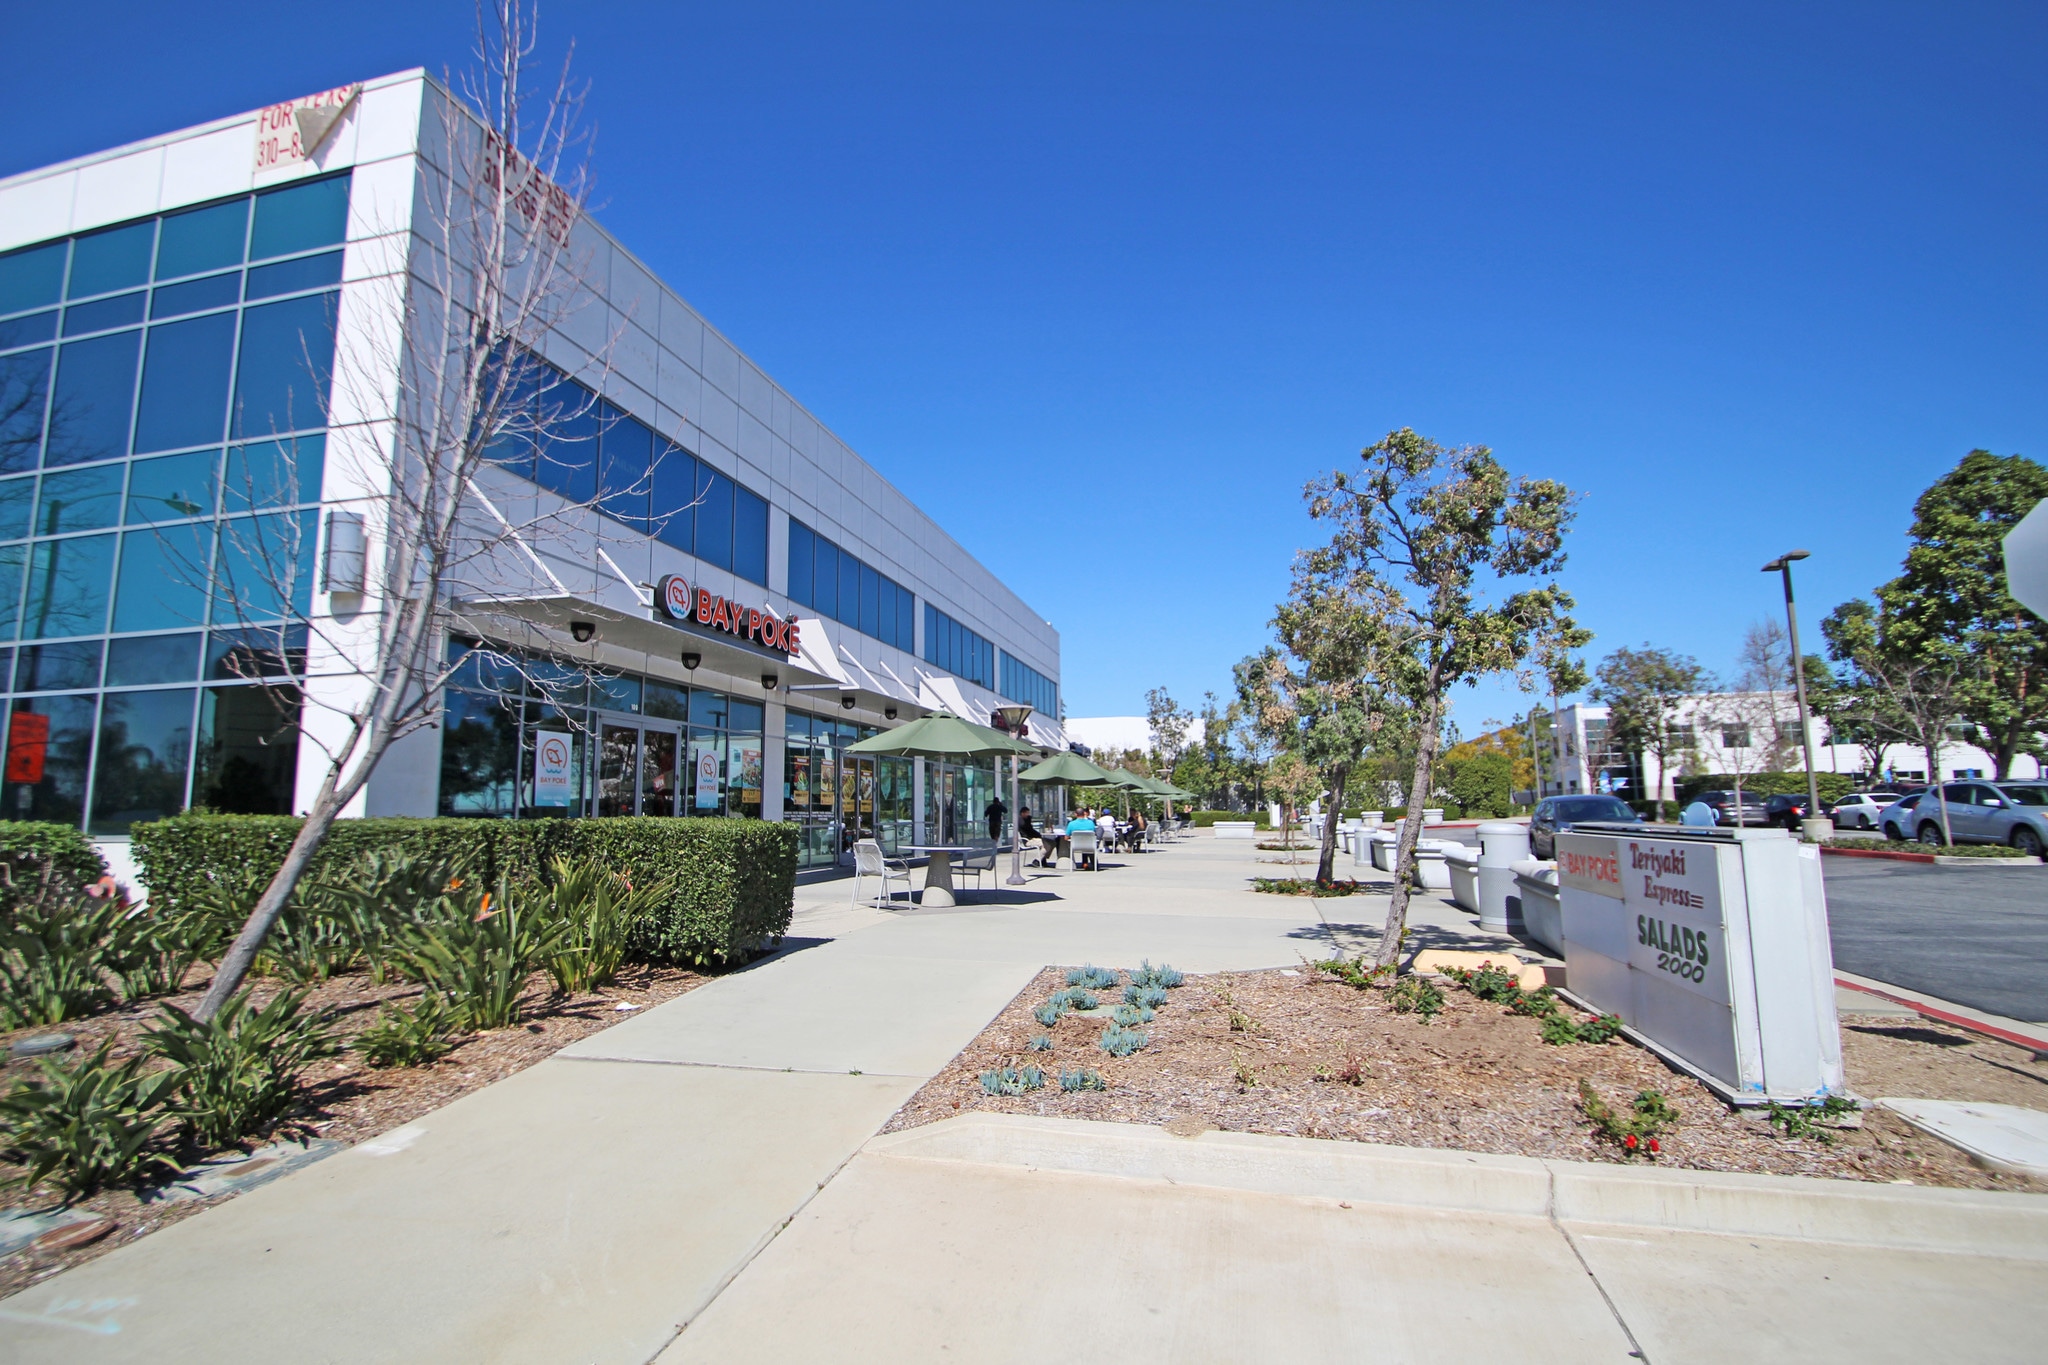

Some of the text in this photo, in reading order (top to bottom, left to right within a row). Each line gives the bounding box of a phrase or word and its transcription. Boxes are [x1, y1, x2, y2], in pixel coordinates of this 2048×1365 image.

[260, 102, 294, 134] FOR
[257, 131, 305, 167] 310-8
[697, 588, 800, 654] BAY POKÉ
[1567, 851, 1619, 884] BAY POKÉ
[1629, 842, 1686, 878] Teriyaki
[1644, 875, 1691, 906] Express
[1638, 914, 1709, 967] SALADS
[1657, 953, 1705, 984] 2000
